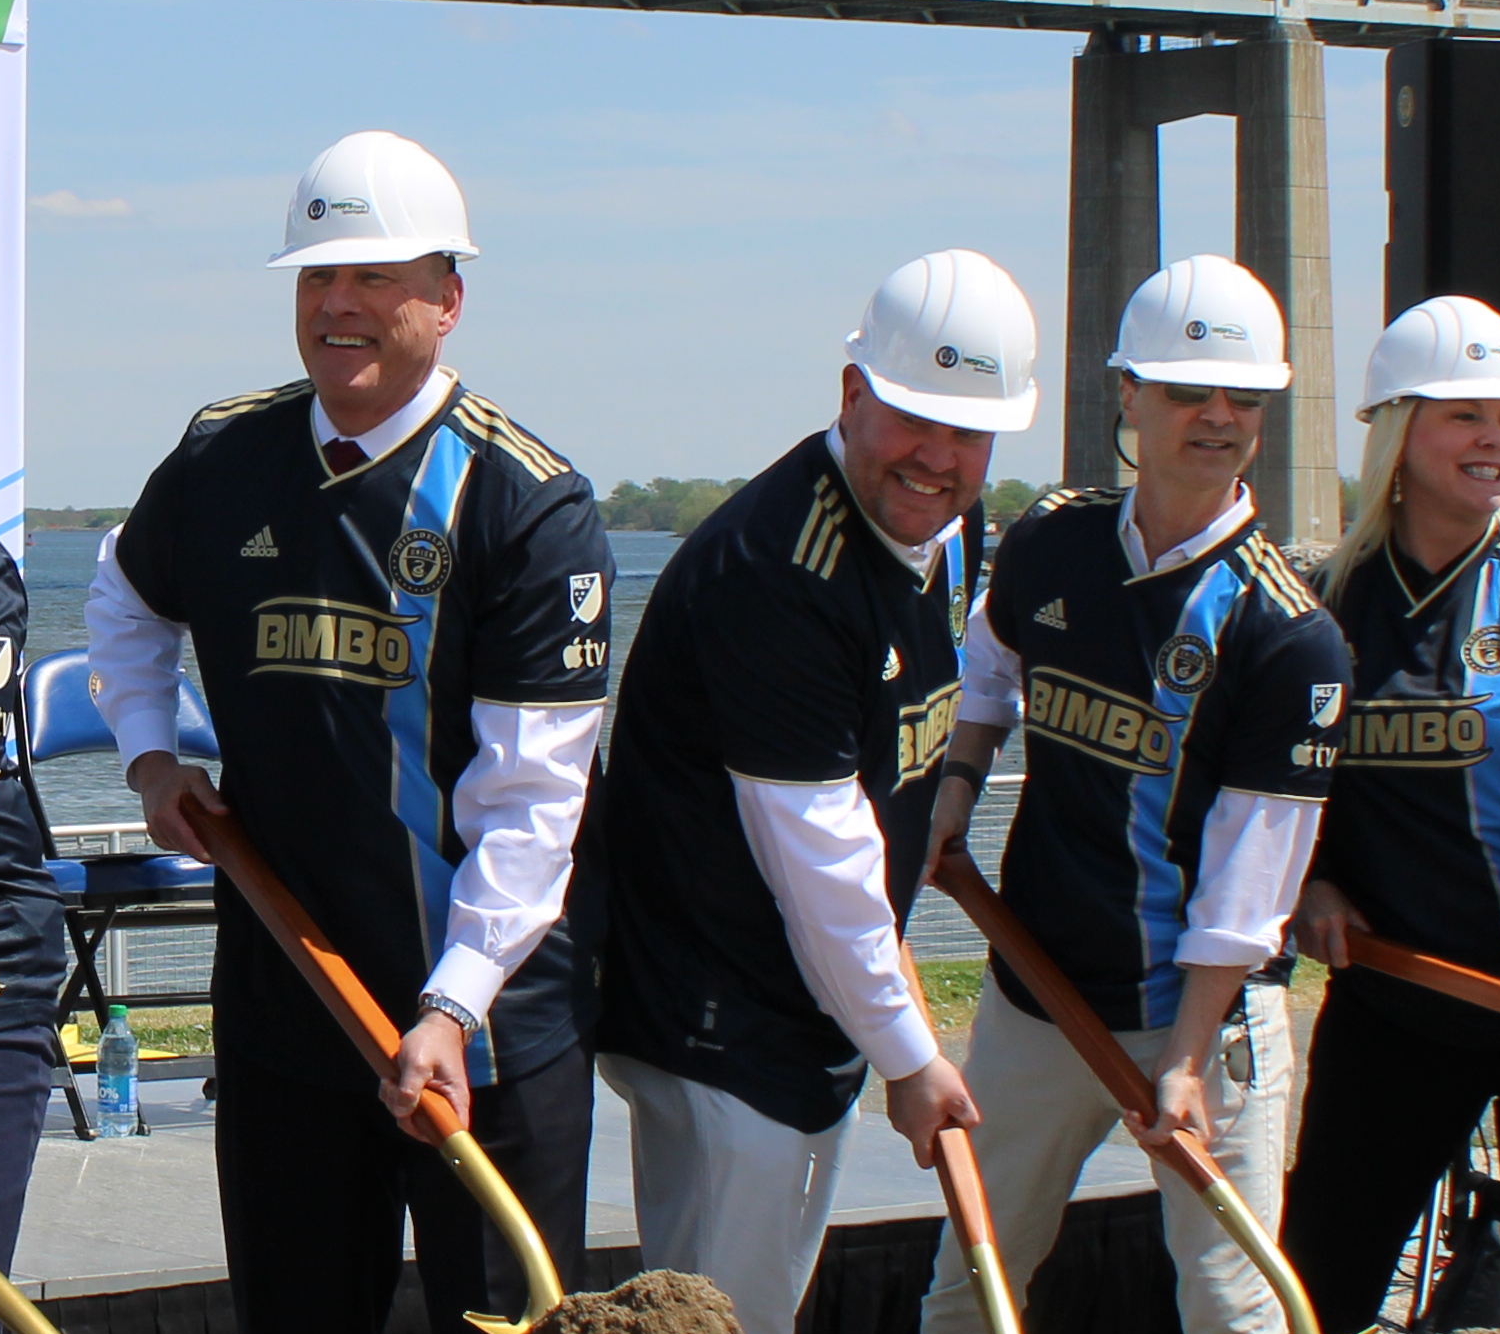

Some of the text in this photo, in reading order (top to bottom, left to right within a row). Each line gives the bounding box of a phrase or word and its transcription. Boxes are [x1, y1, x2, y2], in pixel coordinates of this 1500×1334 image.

[240, 546, 279, 557] adidas
[393, 531, 449, 567] PHILADELPHIA
[410, 548, 435, 560] UNION
[572, 578, 591, 589] MLS
[256, 613, 410, 674] BIMBO
[584, 637, 607, 668] tv
[1027, 677, 1172, 764] BIMBO
[1341, 707, 1485, 755] IMBO
[1314, 738, 1339, 769] tv
